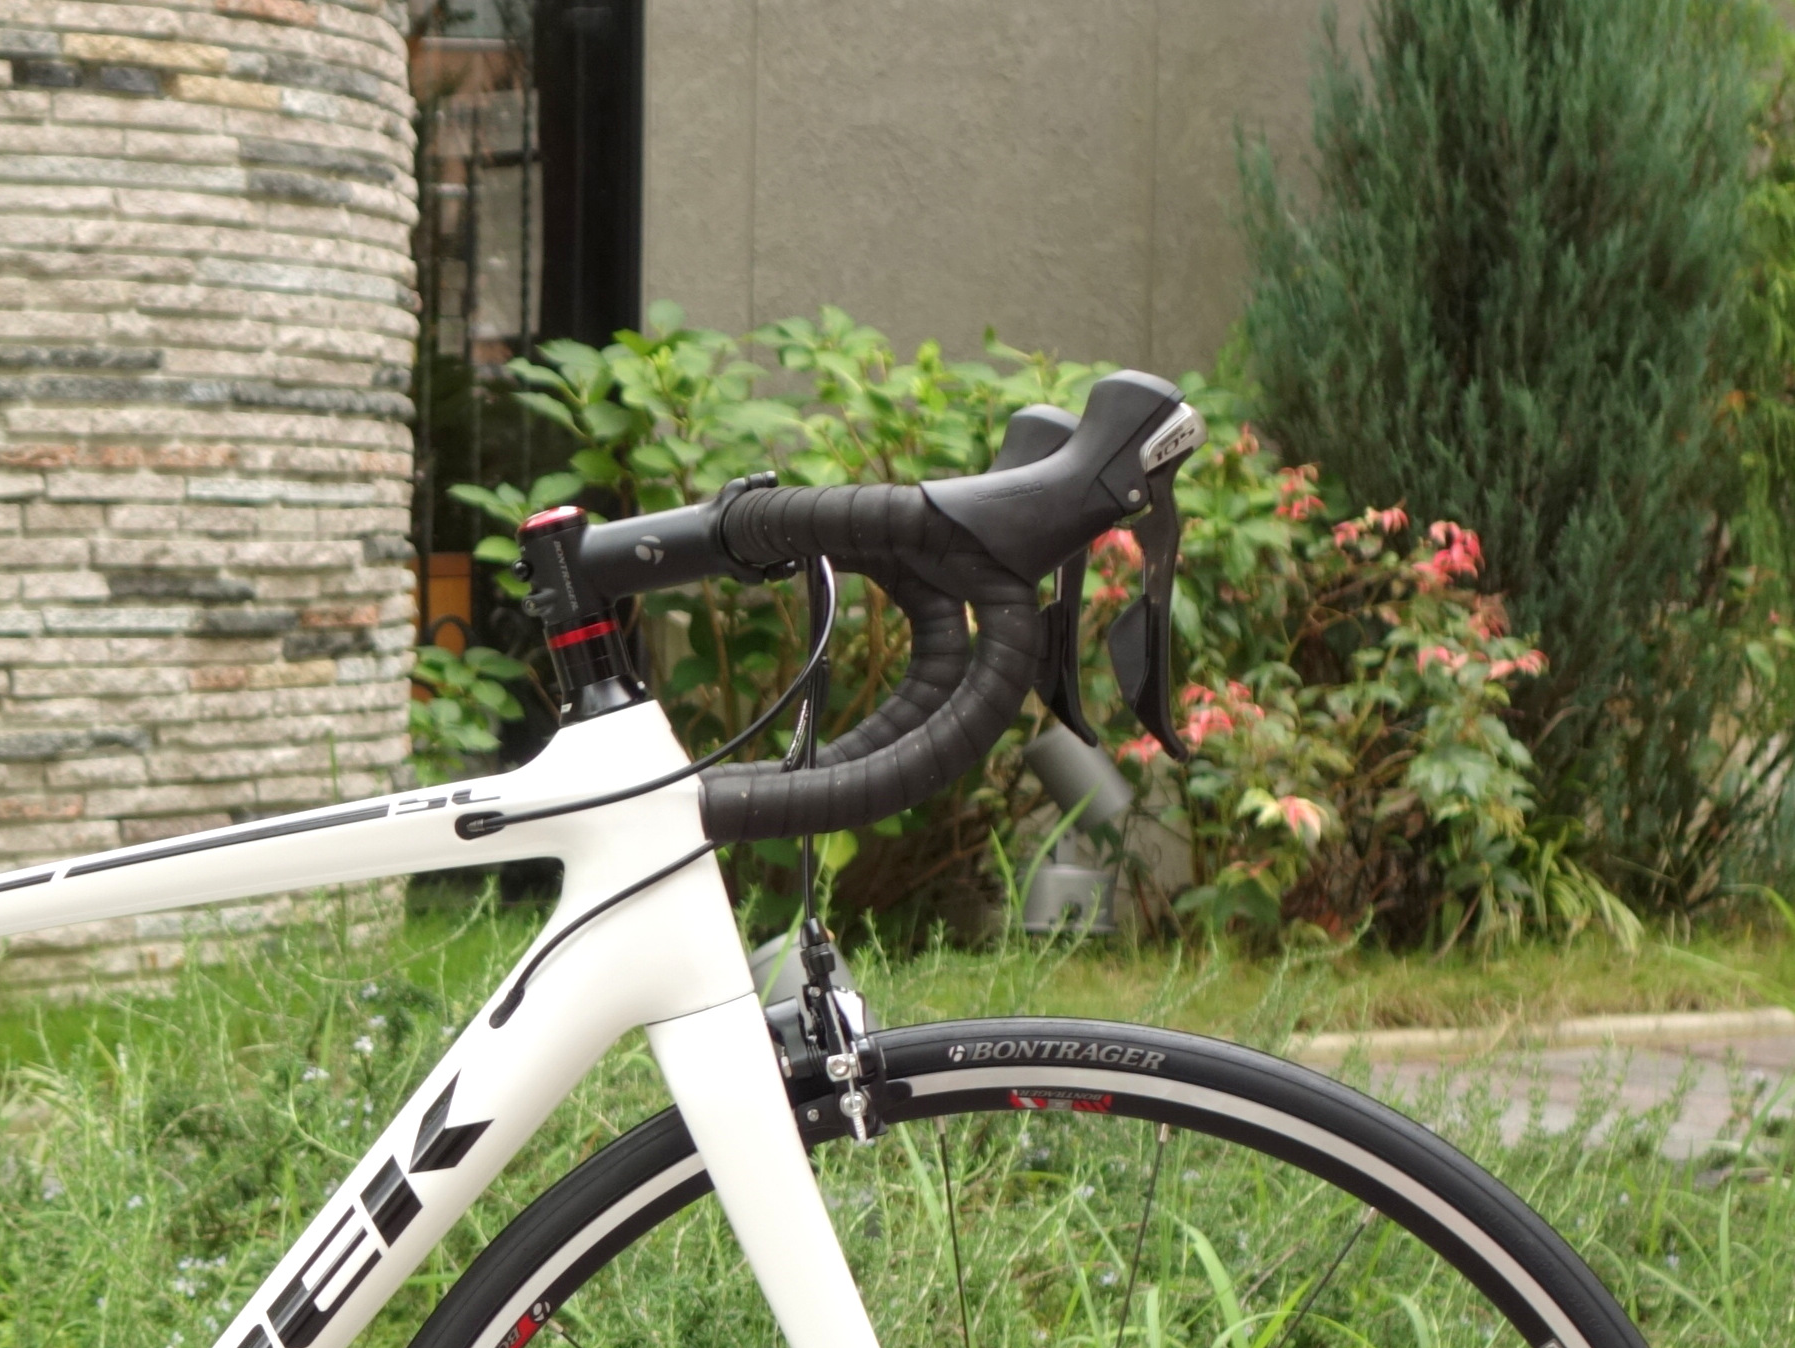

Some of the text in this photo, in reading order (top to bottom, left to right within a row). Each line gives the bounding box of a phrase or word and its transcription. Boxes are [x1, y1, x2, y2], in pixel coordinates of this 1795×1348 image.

[1156, 424, 1195, 461] 105
[553, 541, 578, 611] BONTRAGER
[970, 1040, 1166, 1070] BONTRAGER
